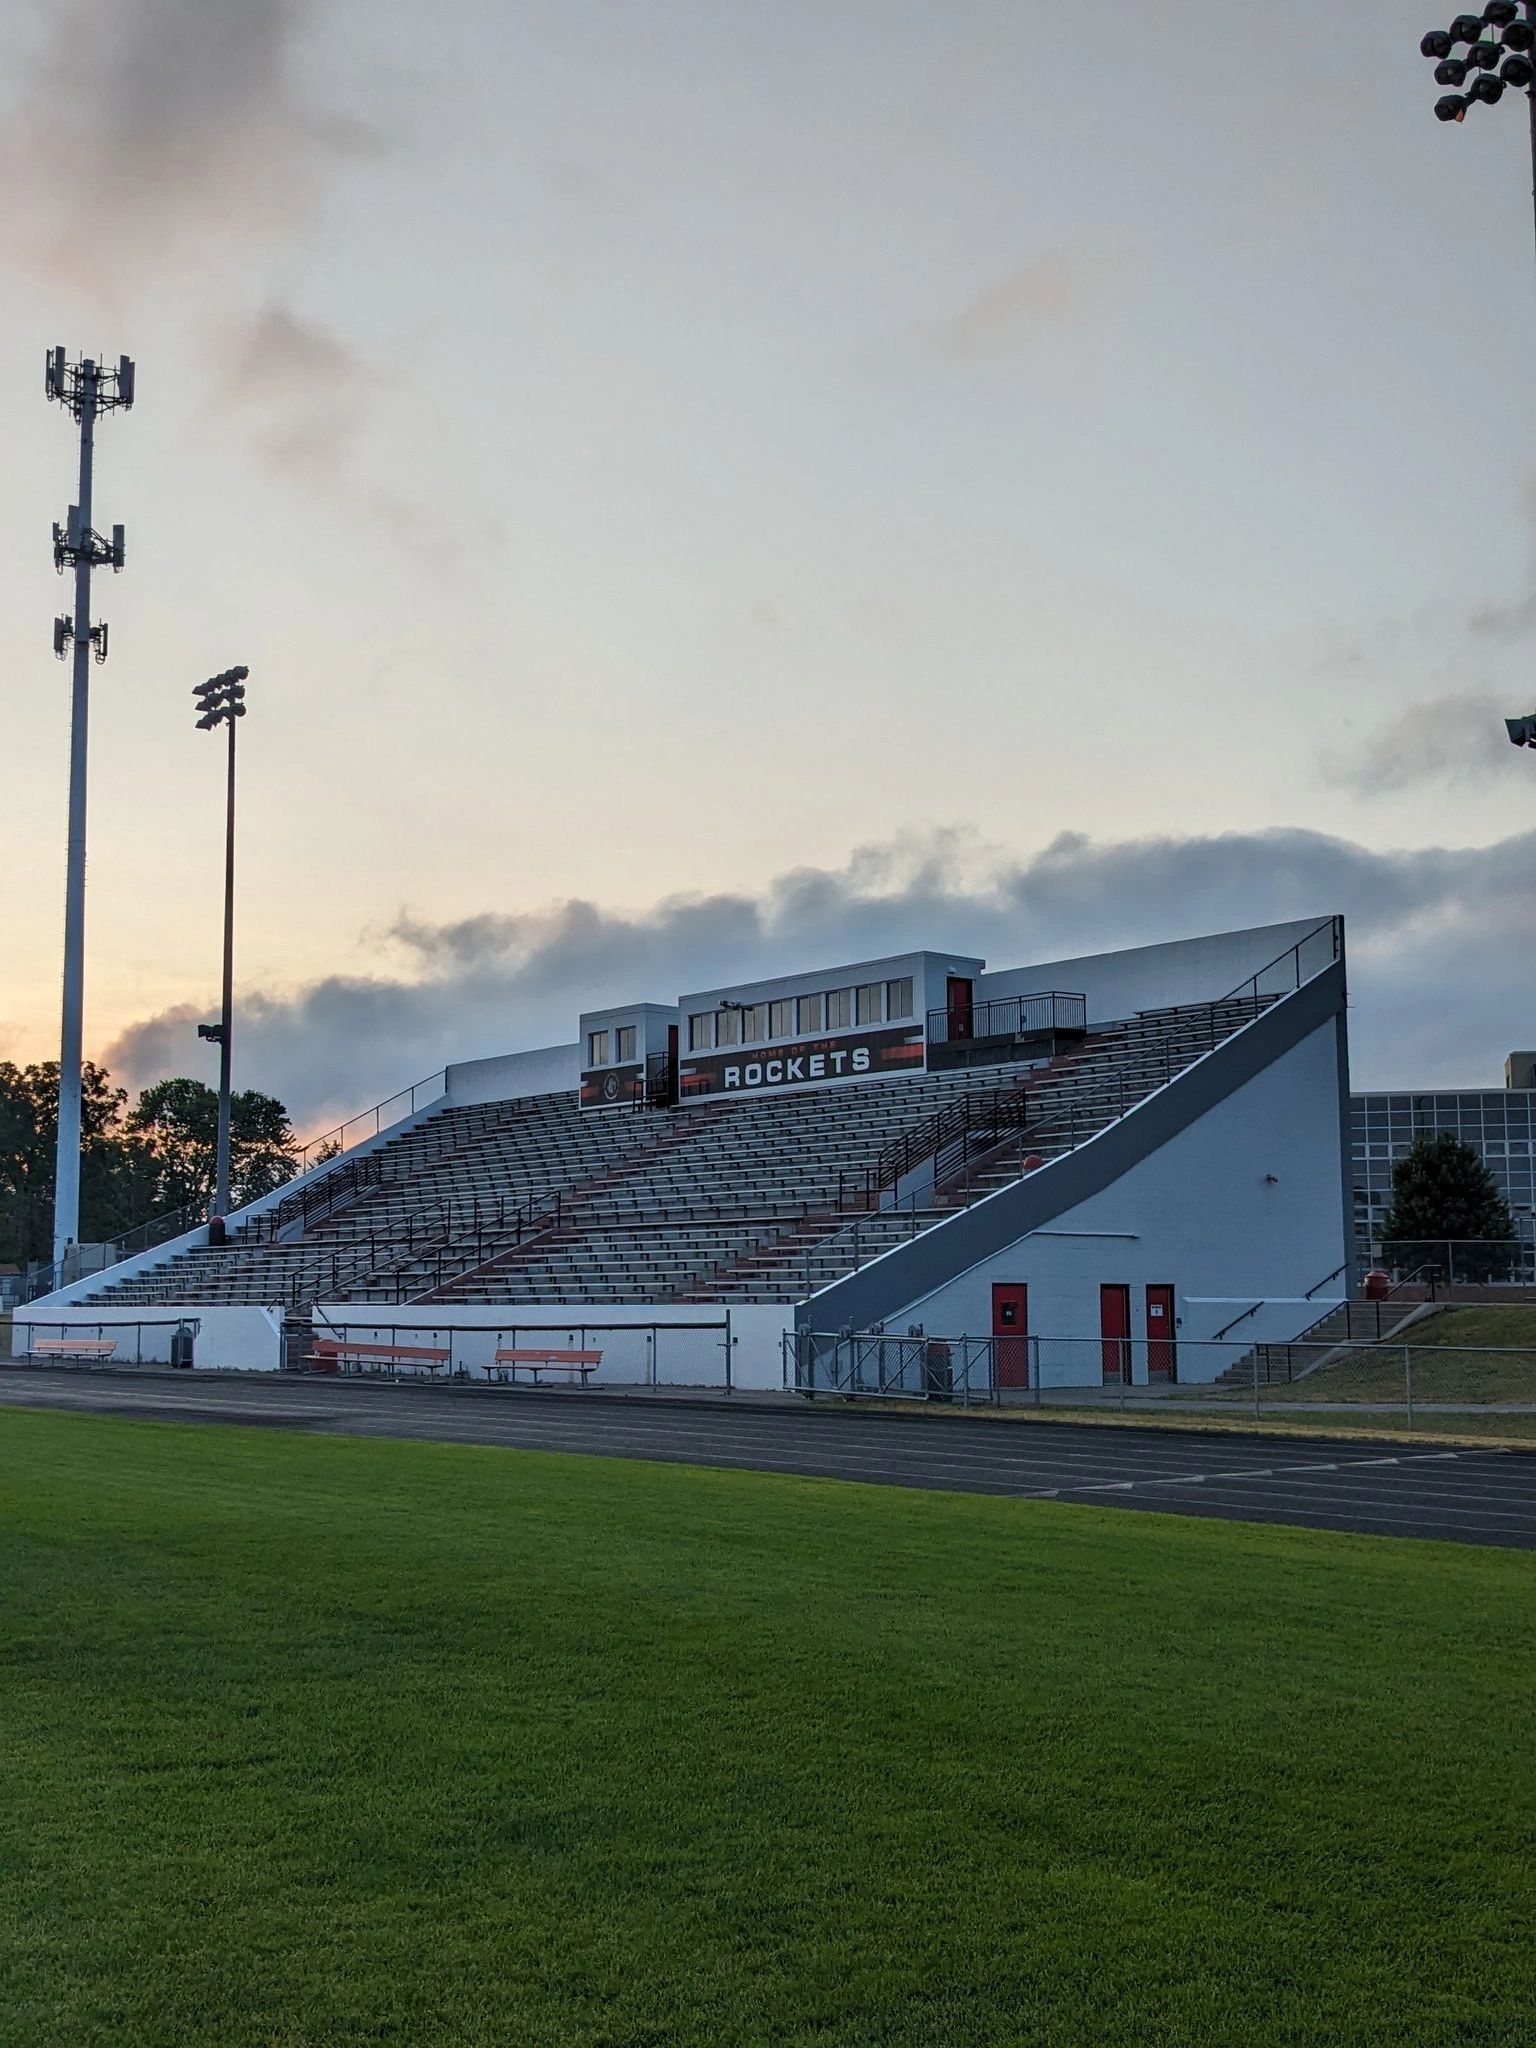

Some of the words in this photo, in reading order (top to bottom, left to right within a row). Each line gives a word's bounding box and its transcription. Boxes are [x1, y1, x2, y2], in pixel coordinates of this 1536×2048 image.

[752, 1049, 784, 1060] HOME
[791, 1045, 806, 1055] OF
[813, 1040, 837, 1050] THE
[724, 1047, 870, 1088] ROCKETS
